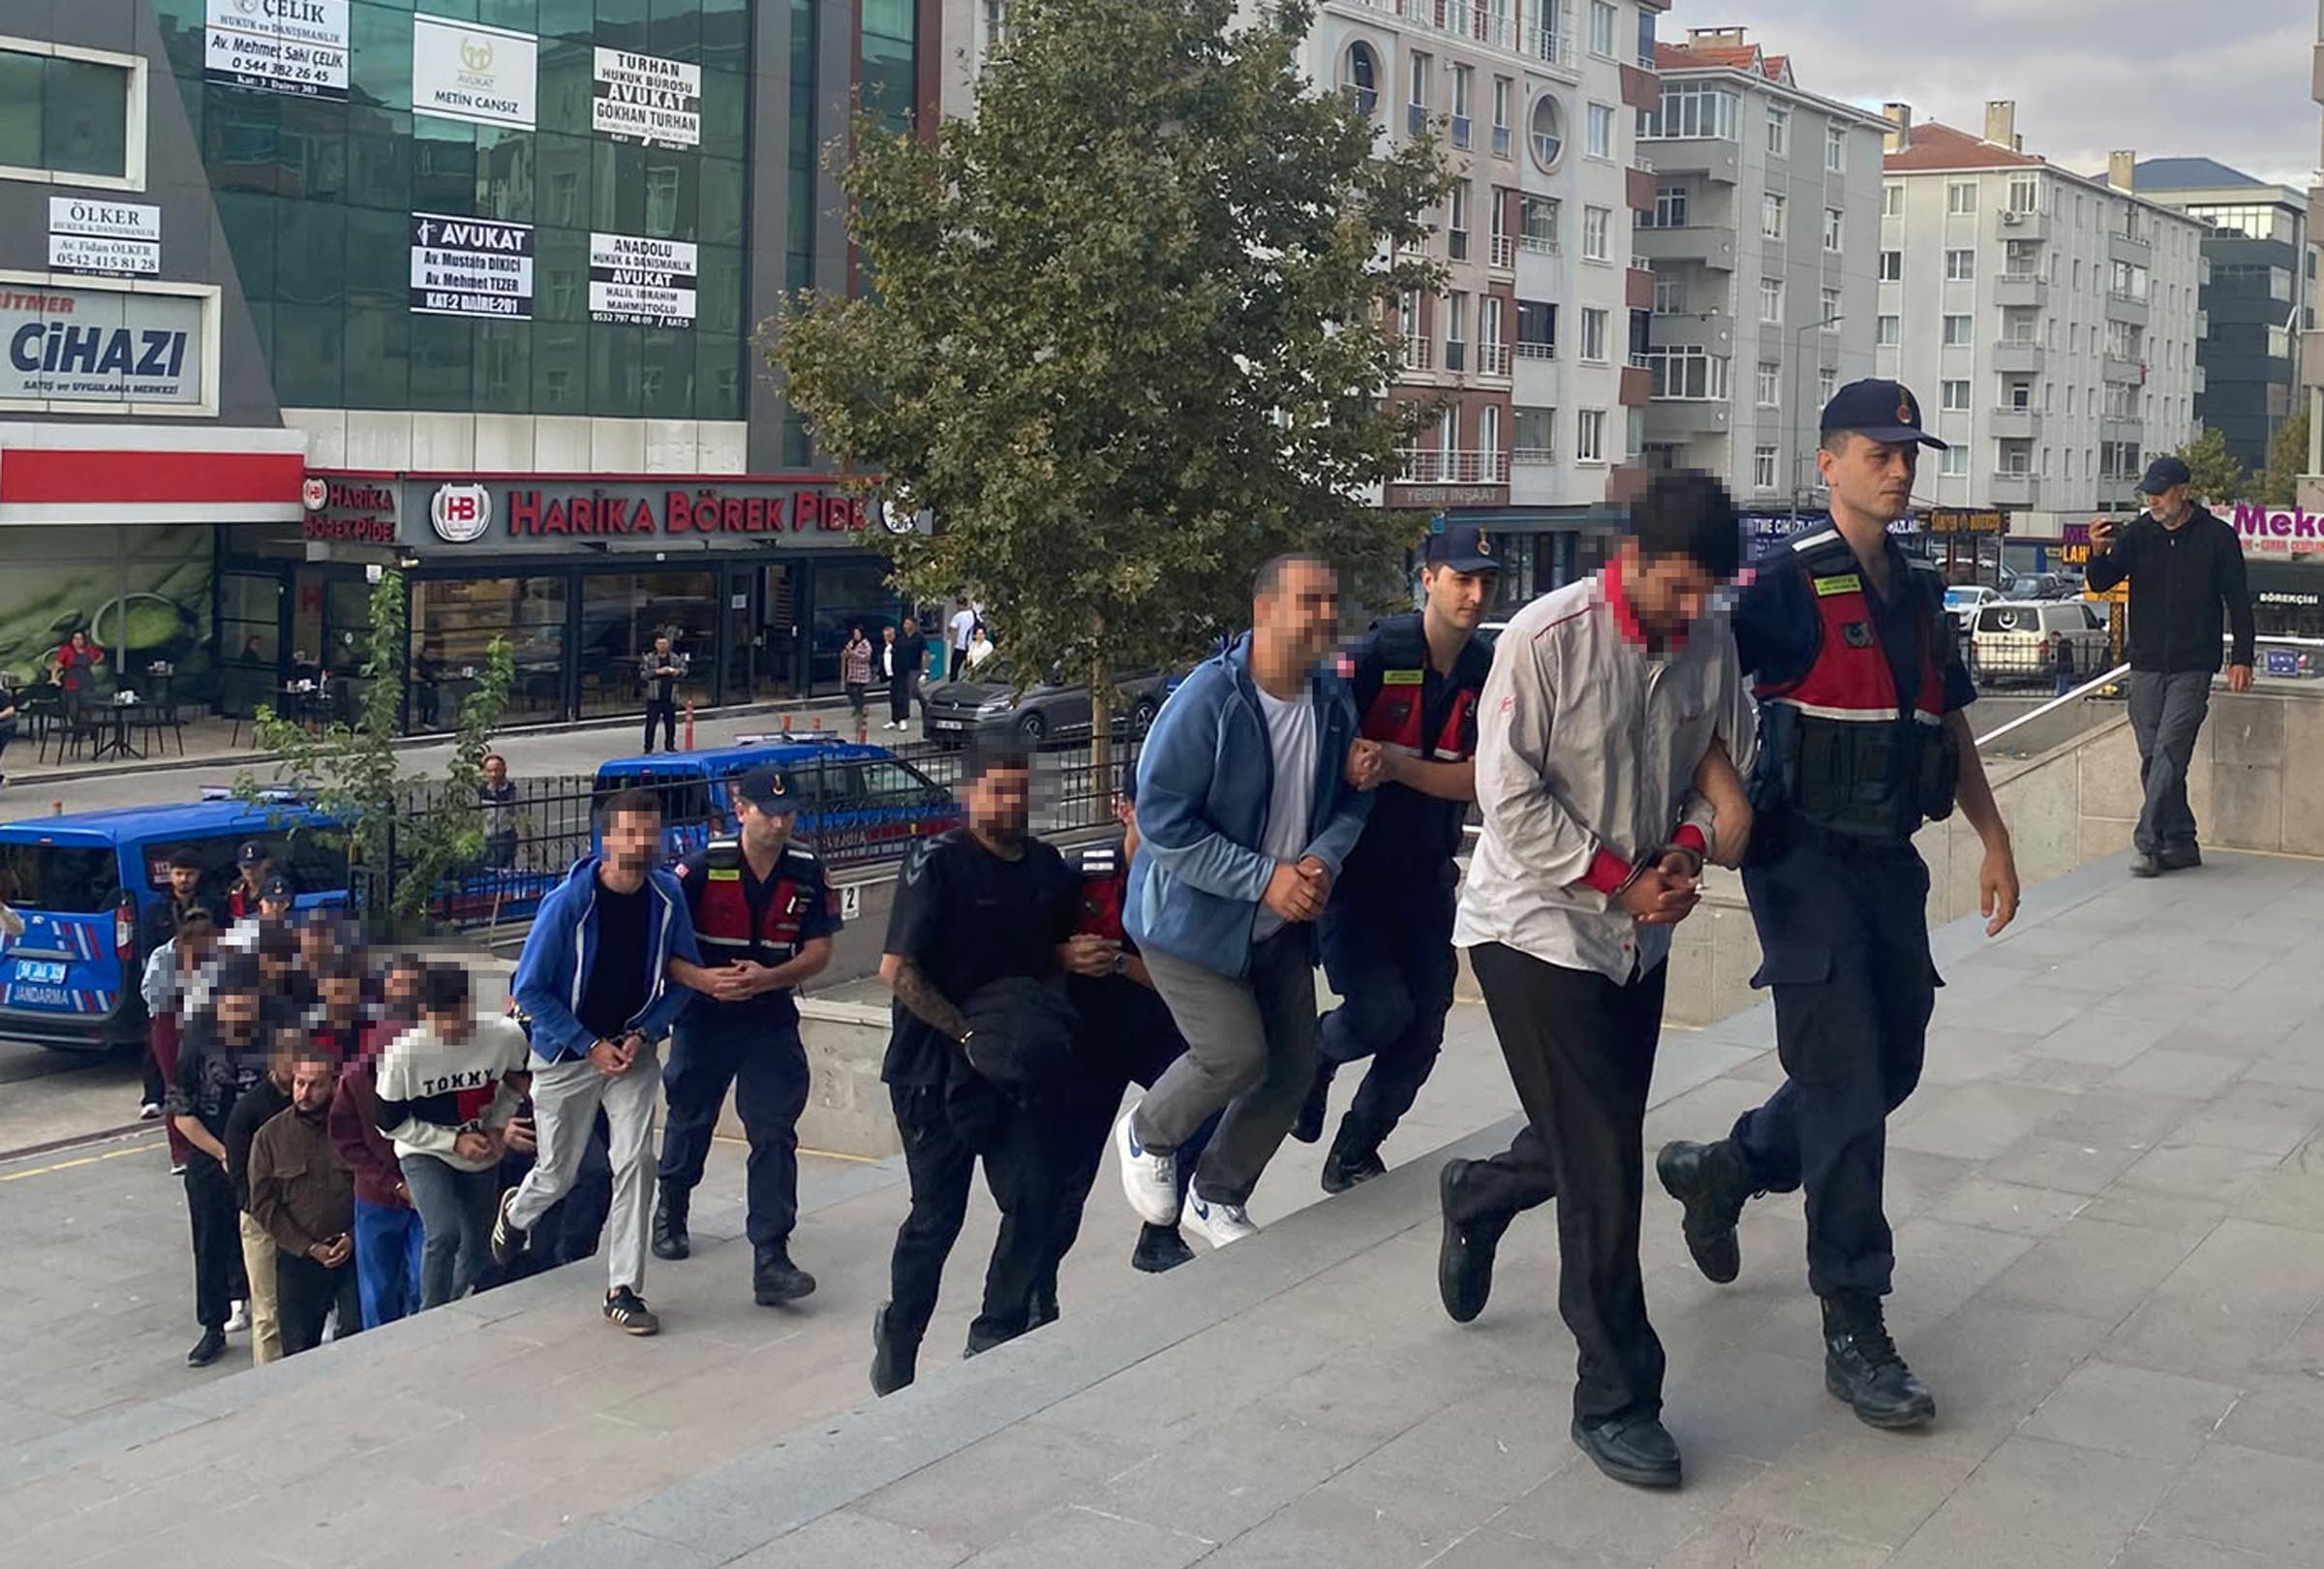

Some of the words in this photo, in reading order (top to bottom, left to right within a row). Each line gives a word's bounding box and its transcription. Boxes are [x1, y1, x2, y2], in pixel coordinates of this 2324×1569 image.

[212, 34, 229, 50] Av.
[232, 37, 282, 59] Mehmet
[244, 58, 267, 73] 544
[295, 68, 311, 79] 26
[314, 70, 329, 82] 45
[617, 52, 680, 77] TURHAN
[601, 68, 642, 85] HUKUK
[474, 96, 519, 114] CANSIZ
[608, 83, 687, 111] AVUKAT
[650, 110, 697, 133] TURHAN
[70, 200, 140, 226] ÖLKER
[441, 222, 526, 251] AVUKAT
[424, 250, 441, 265] Av.
[442, 252, 486, 270] Mustafa
[614, 239, 673, 258] ANADOLU
[56, 253, 90, 266] 0542
[93, 255, 118, 268] 415
[120, 257, 136, 269] 81
[139, 259, 156, 270] 28
[425, 271, 442, 286] Av.
[443, 272, 488, 291] Mehmet
[490, 277, 519, 292] TEZER
[612, 269, 673, 288] AVUKAT
[447, 496, 476, 521] HB
[509, 487, 657, 538] HARİKA
[665, 487, 786, 535] BÖREK
[303, 513, 354, 540] BÖREK
[2063, 544, 2091, 563] LAH
[845, 886, 856, 909] 2
[14, 984, 70, 1005] JANDARMA
[422, 1067, 494, 1095] TOMMY
